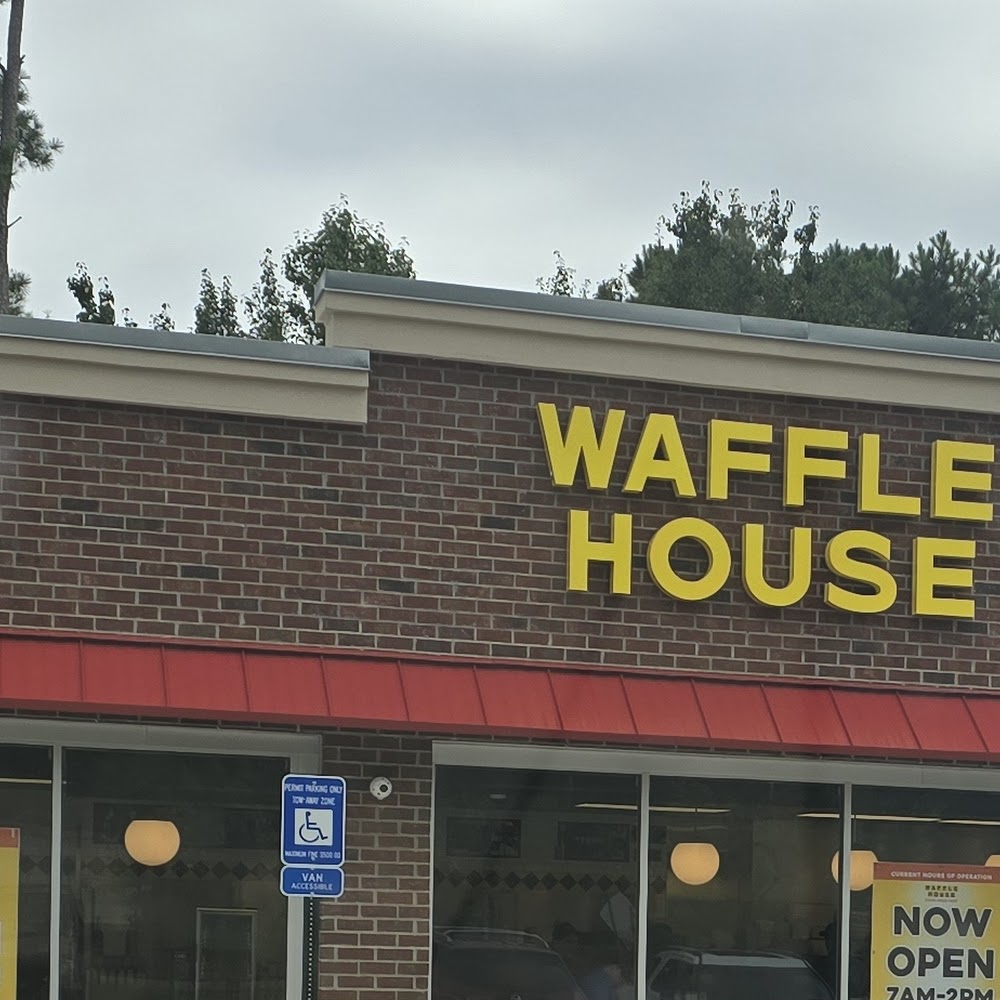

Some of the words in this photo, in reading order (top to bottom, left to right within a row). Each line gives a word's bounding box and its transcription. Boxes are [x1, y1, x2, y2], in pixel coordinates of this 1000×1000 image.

[537, 402, 994, 521] WAFFLE
[567, 509, 976, 618] HOUSE
[301, 873, 324, 882] VAN
[893, 905, 992, 937] NOW
[887, 946, 994, 979] OPEN
